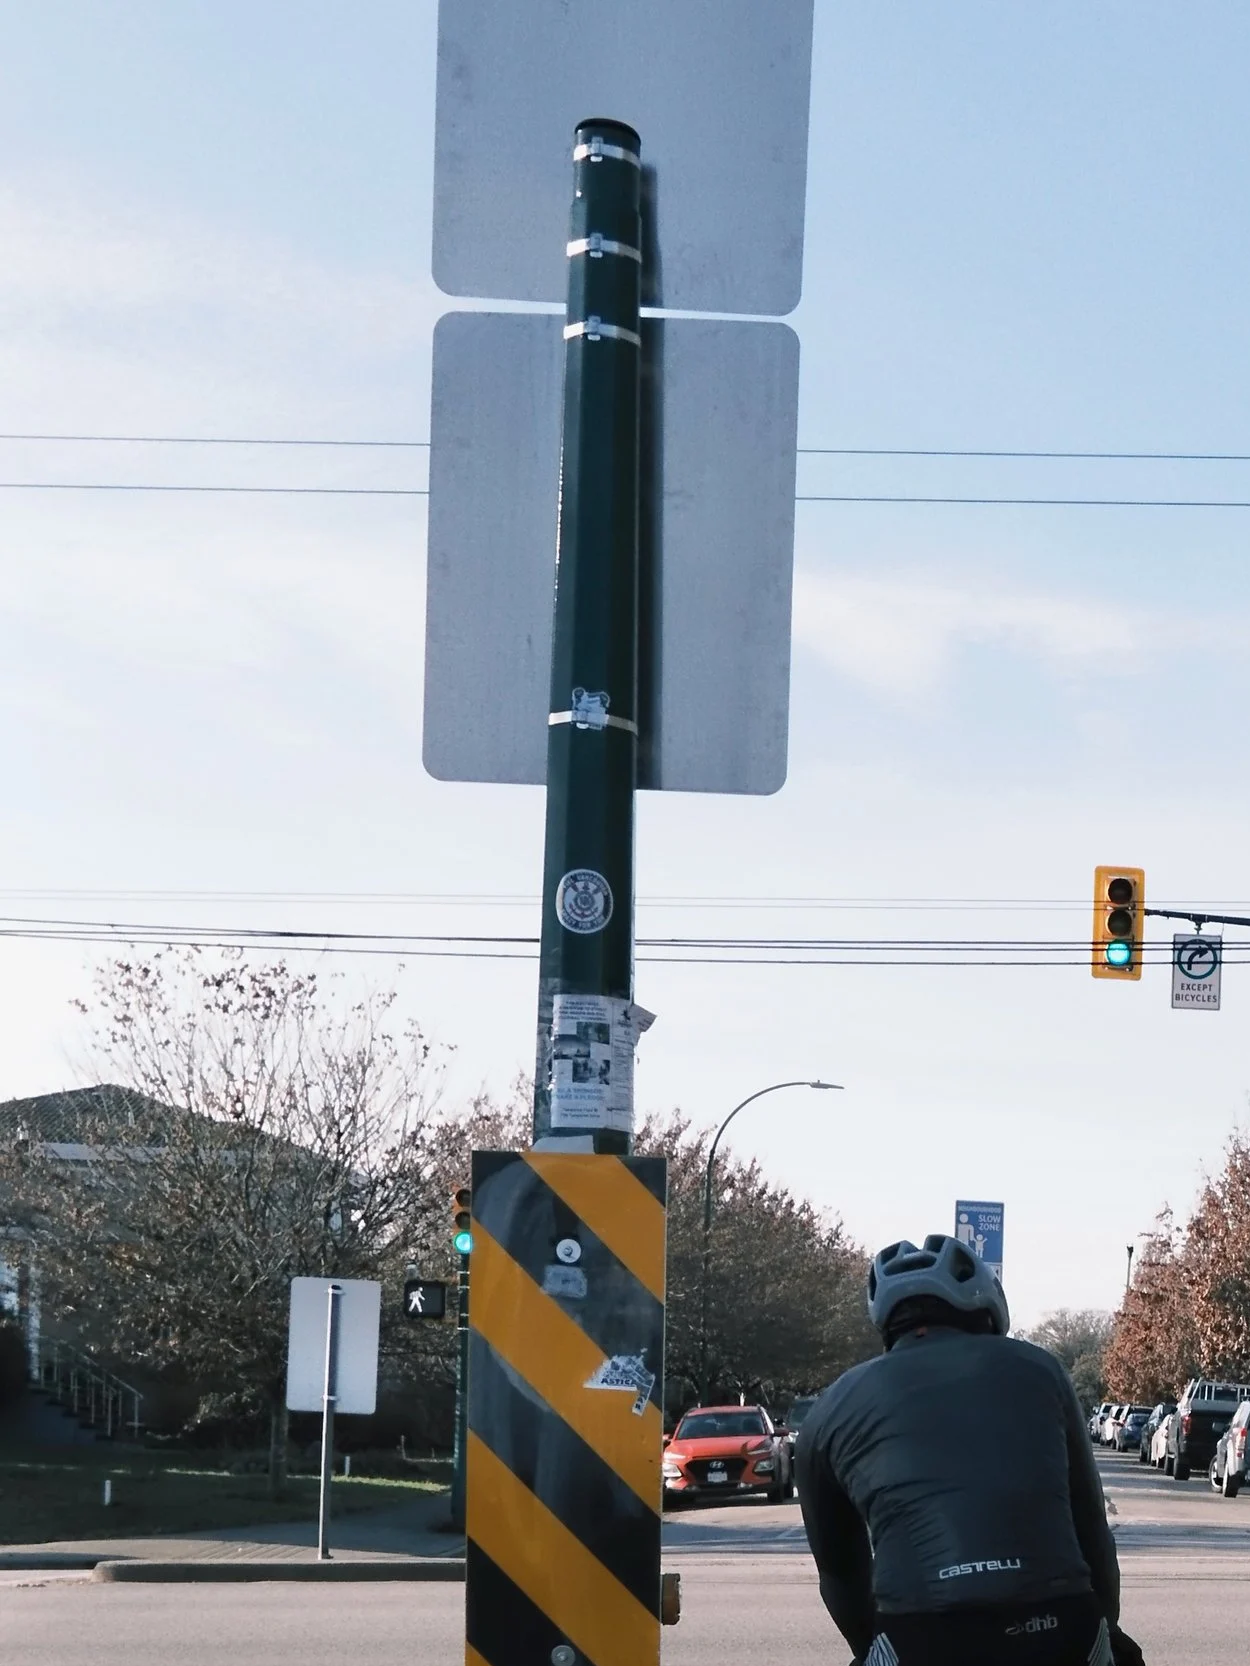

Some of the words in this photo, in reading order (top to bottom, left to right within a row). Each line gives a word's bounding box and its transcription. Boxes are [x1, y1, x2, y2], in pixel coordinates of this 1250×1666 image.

[1180, 982, 1213, 992] EXCEPT
[1175, 993, 1217, 1003] BICYCLES
[978, 1214, 1001, 1223] SLOW
[978, 1223, 1000, 1232] ZONE
[1025, 1614, 1058, 1633] dhb
